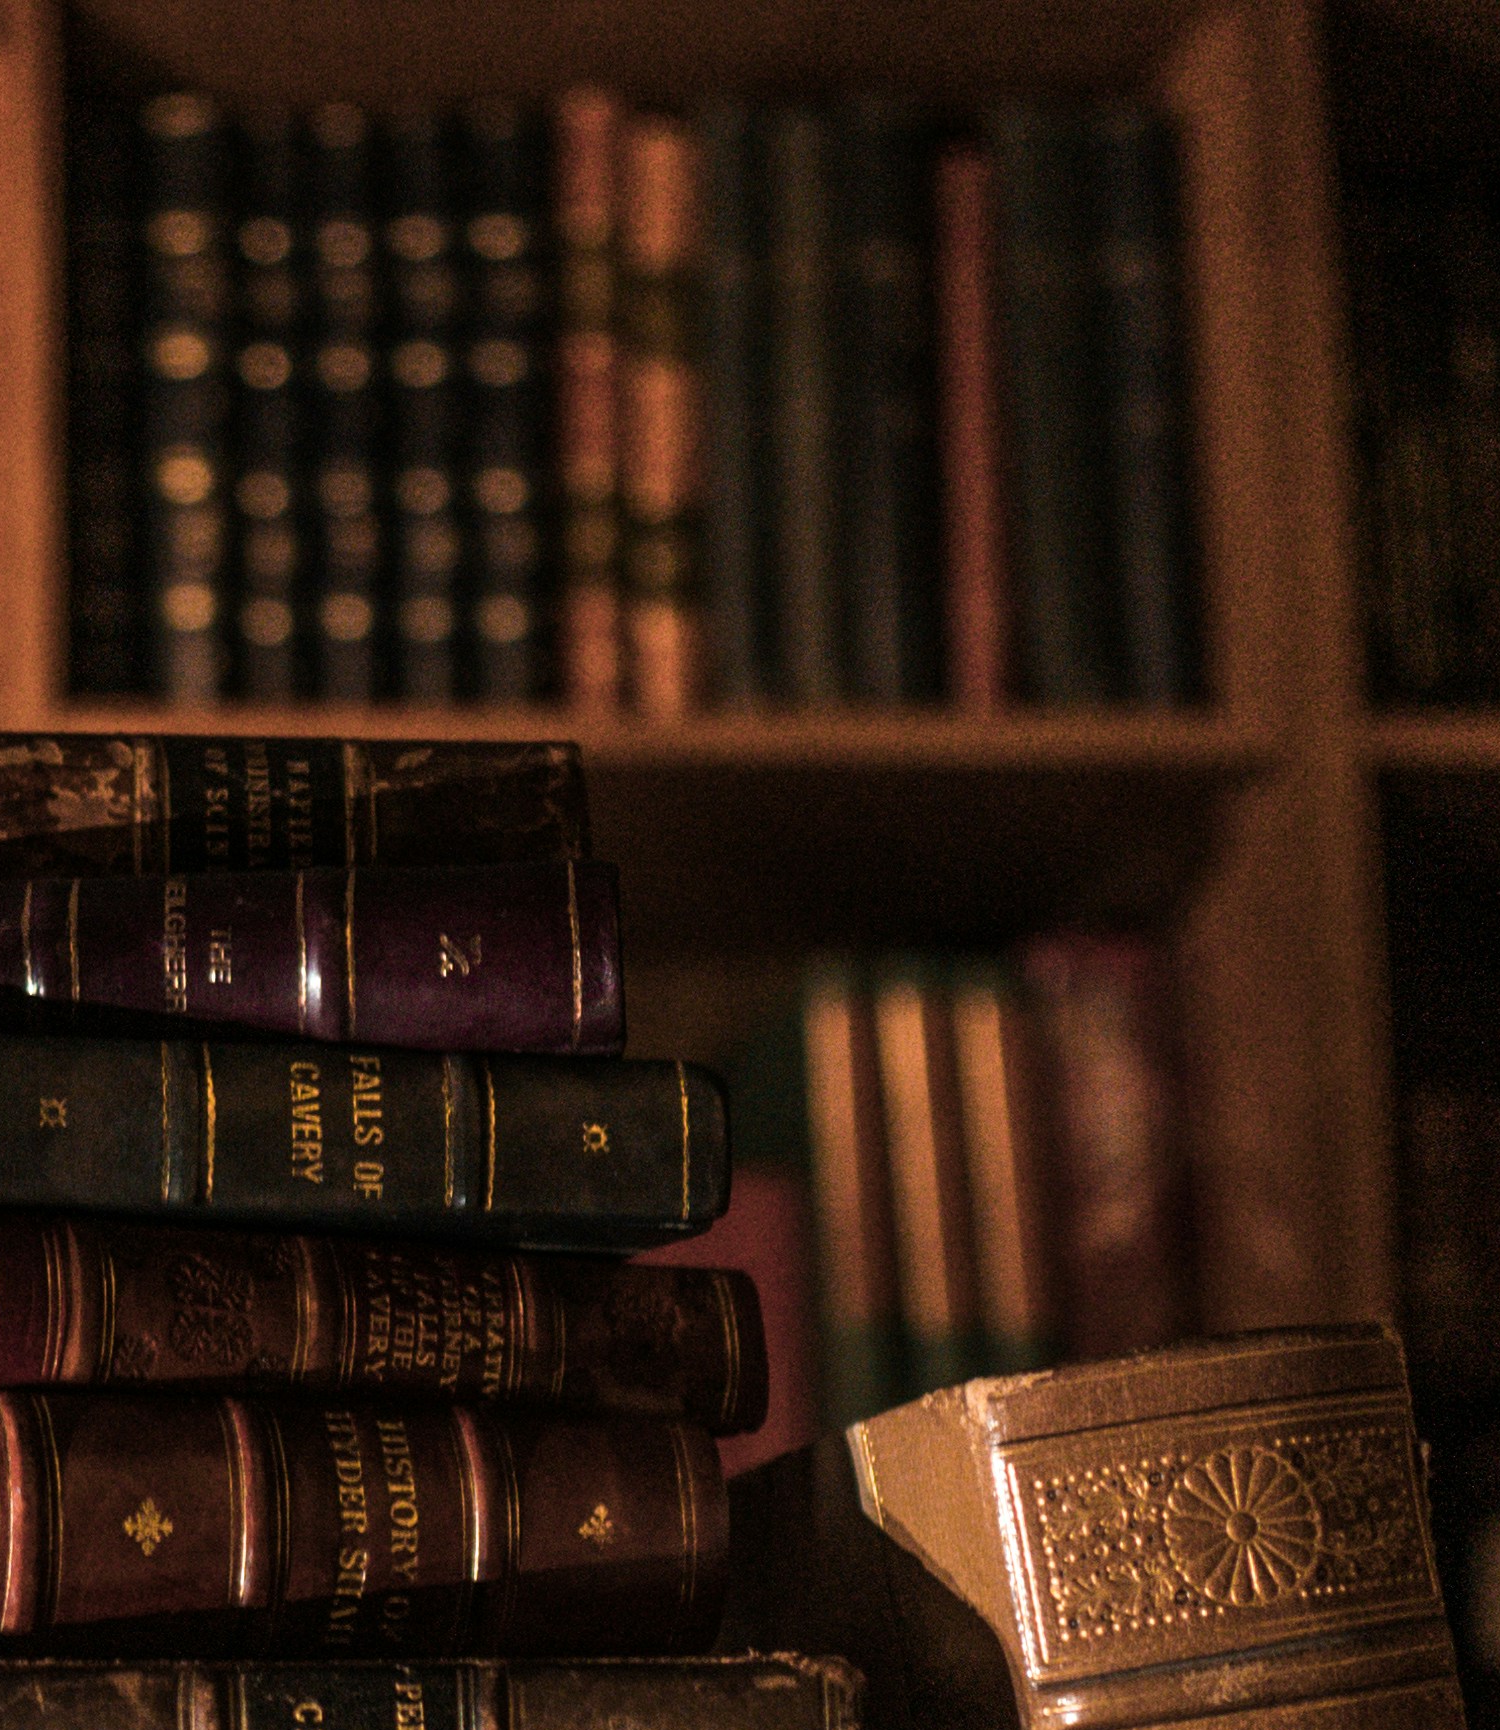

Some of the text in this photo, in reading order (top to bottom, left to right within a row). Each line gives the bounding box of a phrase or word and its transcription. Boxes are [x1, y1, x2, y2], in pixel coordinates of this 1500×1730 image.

[207, 926, 234, 985] THE
[289, 1061, 324, 1185] CAVERY
[349, 1054, 385, 1200] FALLS OF
[391, 1307, 416, 1371] THE
[323, 1410, 370, 1535] HYDER
[376, 1418, 420, 1582] HISTORY
